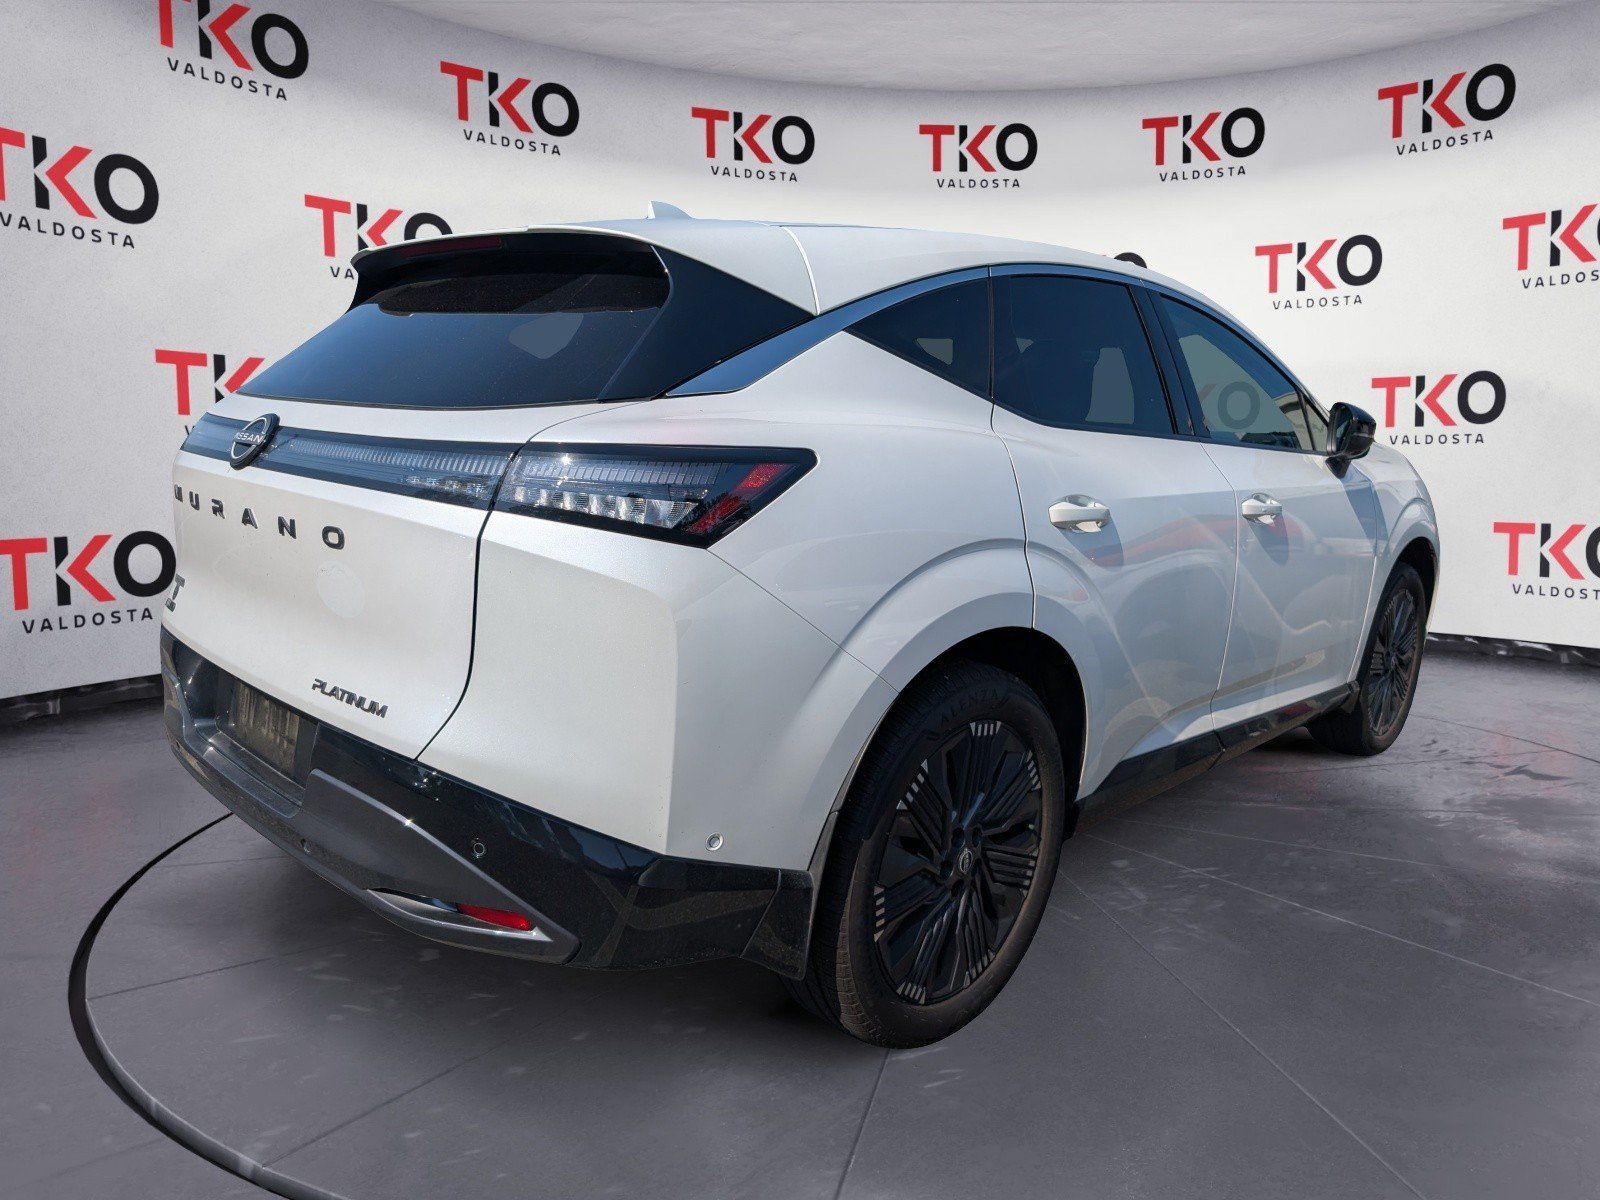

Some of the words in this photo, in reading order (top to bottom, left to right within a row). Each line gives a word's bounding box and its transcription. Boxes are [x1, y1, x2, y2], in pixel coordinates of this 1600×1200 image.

[156, 0, 309, 80] TKO
[167, 56, 287, 101] VALDOSTA
[440, 60, 580, 138] TKO
[1377, 63, 1517, 139] TKO
[463, 128, 561, 156] VALDOSTA
[691, 106, 816, 165] TKO
[918, 122, 1038, 173] TKO
[1141, 106, 1266, 166] TKO
[1396, 129, 1493, 156] VALDOSTA
[710, 165, 798, 183] VALDOSTA
[936, 178, 1020, 189] VALDOSTA
[1159, 165, 1246, 182] VALDOSTA
[0, 211, 135, 249] VALDOSTA
[1502, 204, 1600, 271] TK
[1255, 234, 1383, 294] TKO
[1522, 269, 1600, 289] VALDOS
[1272, 294, 1363, 310] VALDOSTA
[154, 349, 265, 416] TK
[1371, 370, 1507, 428] TKO
[1389, 433, 1485, 446] VALDOSTA
[0, 530, 177, 611] TKO
[1493, 521, 1600, 580] TK
[1512, 583, 1600, 600] VALDOST
[22, 607, 153, 635] VALDOSTA
[311, 678, 389, 719] PLATINUM
